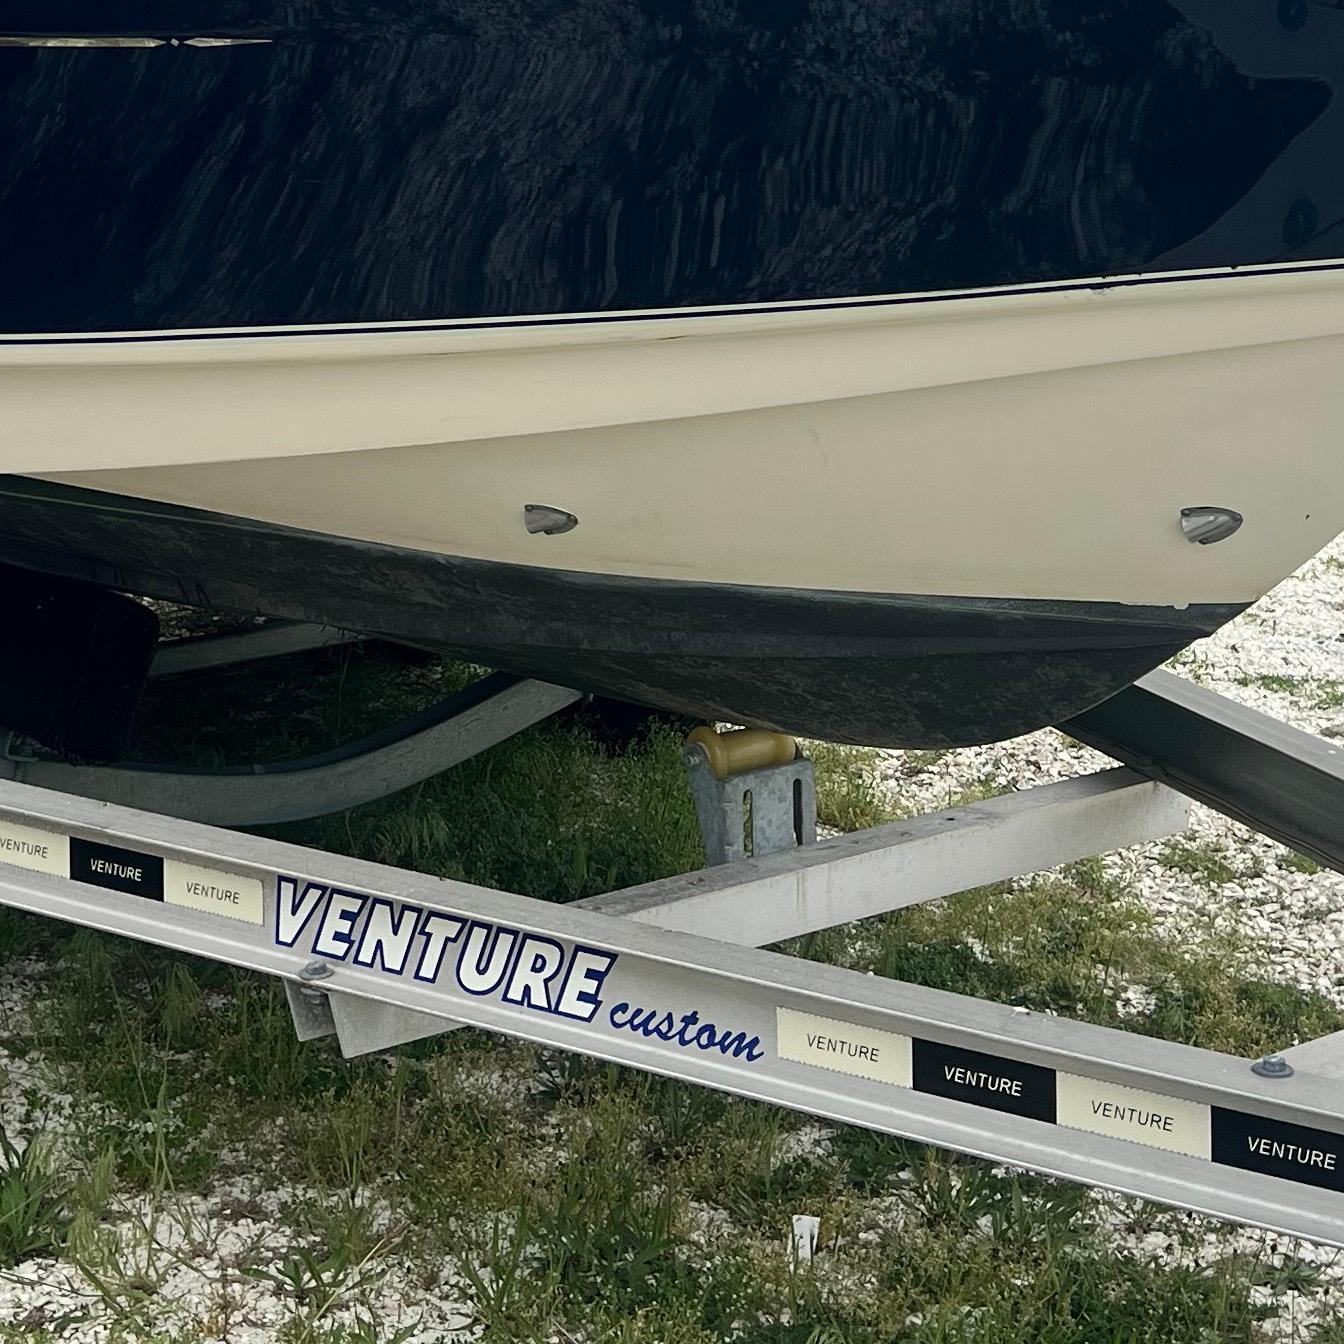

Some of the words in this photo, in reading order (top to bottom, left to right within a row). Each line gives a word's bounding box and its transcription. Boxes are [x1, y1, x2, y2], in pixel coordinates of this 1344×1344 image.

[0, 837, 49, 859] VENTURE
[90, 858, 142, 882] VENTURE
[186, 882, 241, 905] VENTURE
[273, 874, 617, 1023] VENTURE
[607, 1001, 764, 1062] custom
[806, 1032, 880, 1064] VENTURE
[943, 1063, 1023, 1098] VENTURE
[1090, 1099, 1175, 1134] VENTURE
[1246, 1136, 1337, 1170] VENTURE
